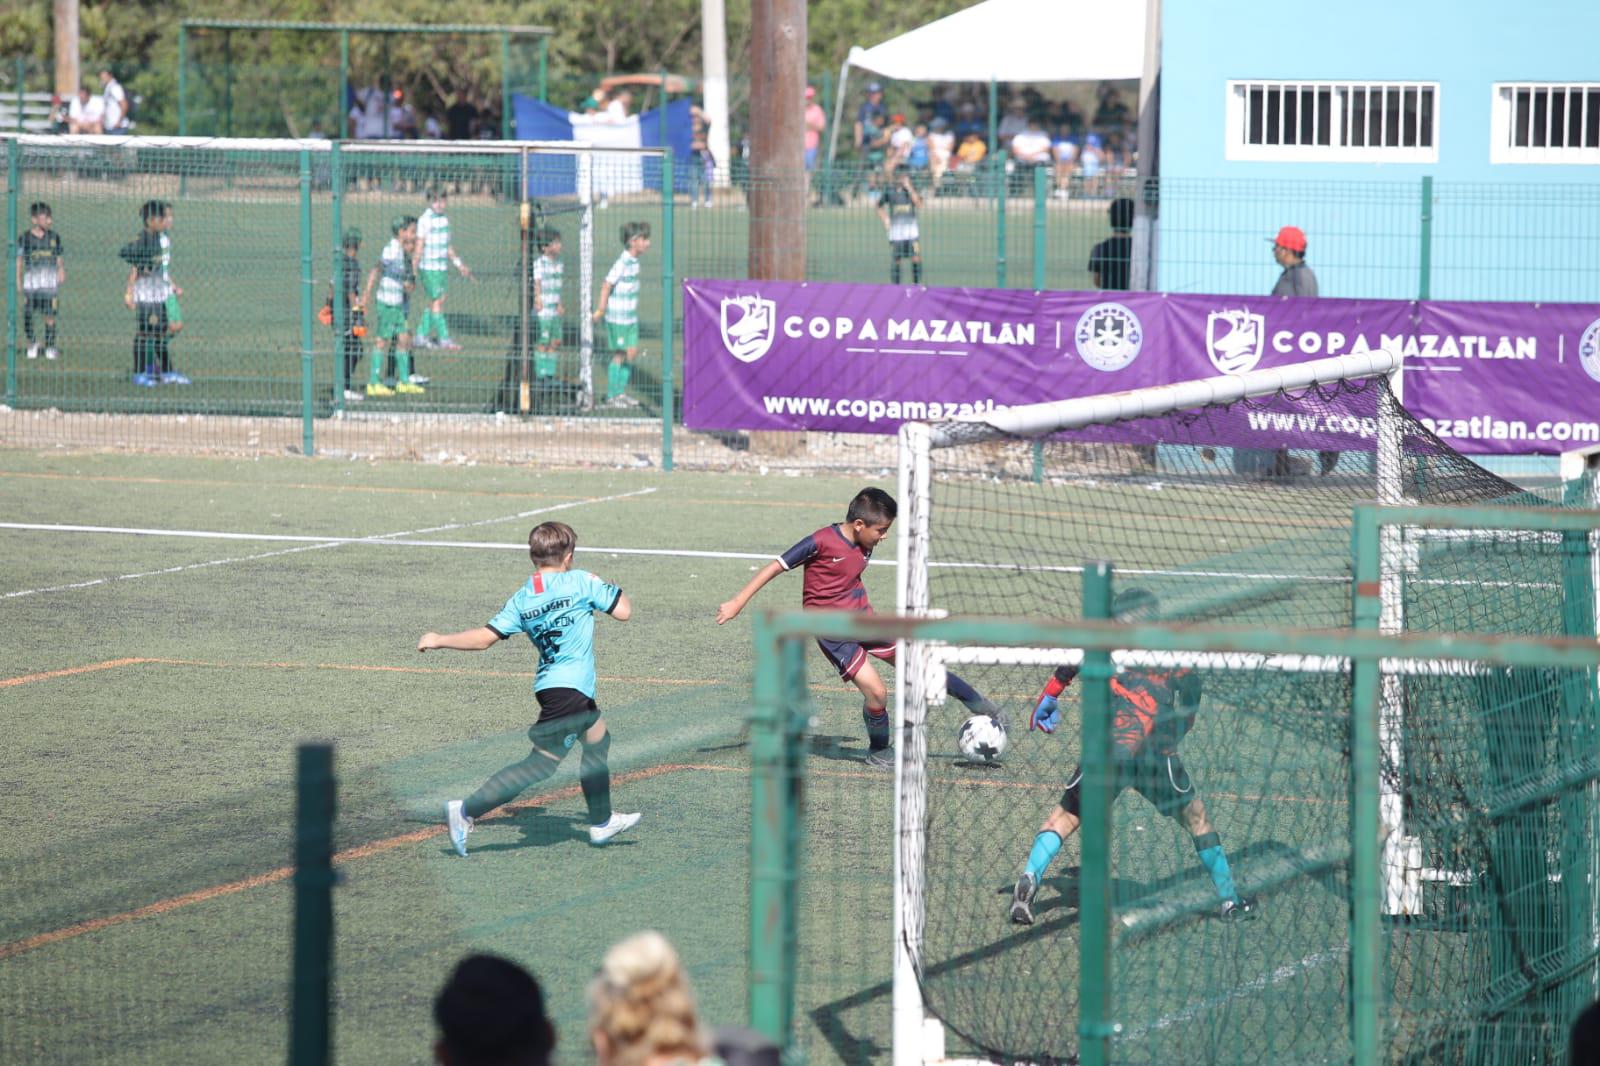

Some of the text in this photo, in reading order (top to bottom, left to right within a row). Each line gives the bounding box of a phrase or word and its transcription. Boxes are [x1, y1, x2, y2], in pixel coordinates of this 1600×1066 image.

[783, 316, 879, 341] COPA
[1272, 330, 1370, 354] COPA
[764, 394, 1024, 422] www.copamazatl
[1247, 411, 1599, 442] www.copazatlan.com
